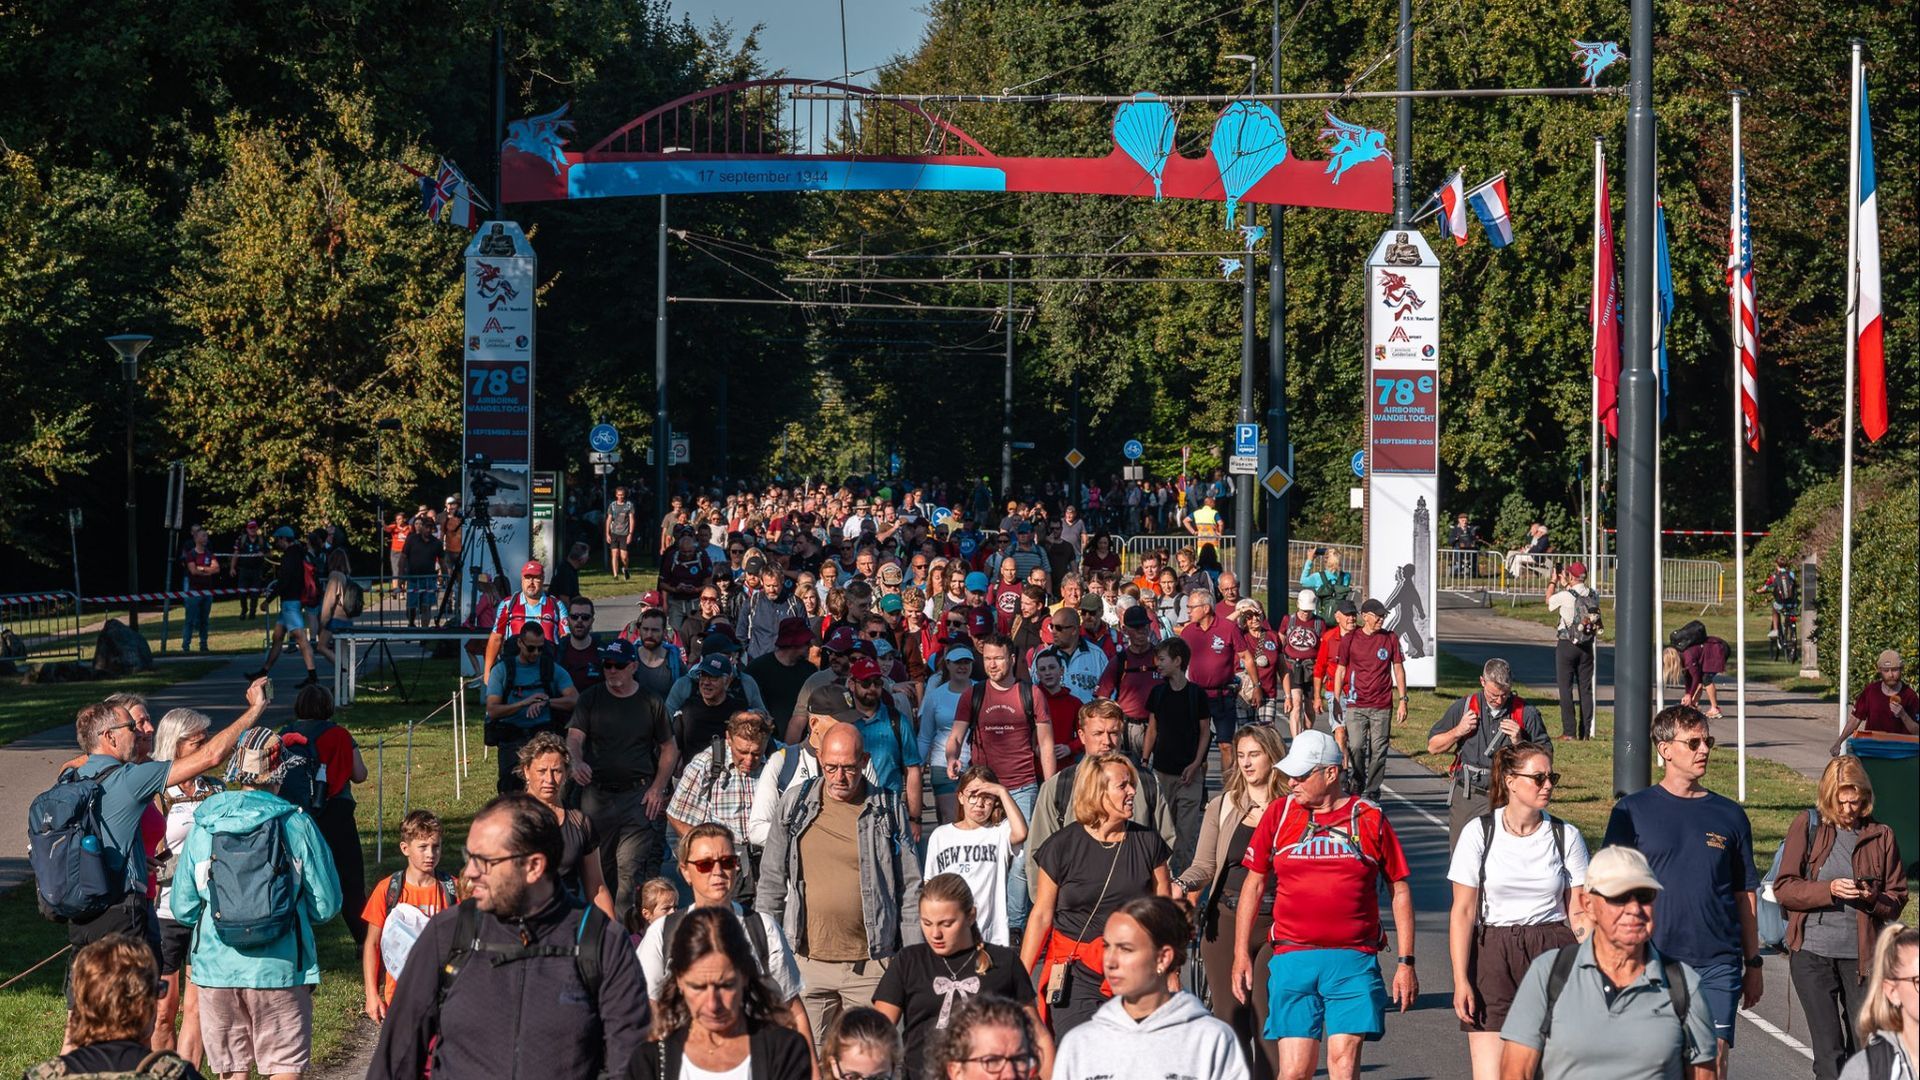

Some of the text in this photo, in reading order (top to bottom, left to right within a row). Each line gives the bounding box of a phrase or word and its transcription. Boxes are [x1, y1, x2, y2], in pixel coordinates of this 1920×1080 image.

[699, 170, 828, 185] 17 september 1944
[1375, 376, 1434, 405] 78e
[1373, 414, 1436, 422] WANDELTOCHT
[1383, 406, 1425, 414] AIRBORNE
[1240, 427, 1253, 444] P
[936, 843, 997, 874] NEW YORK
